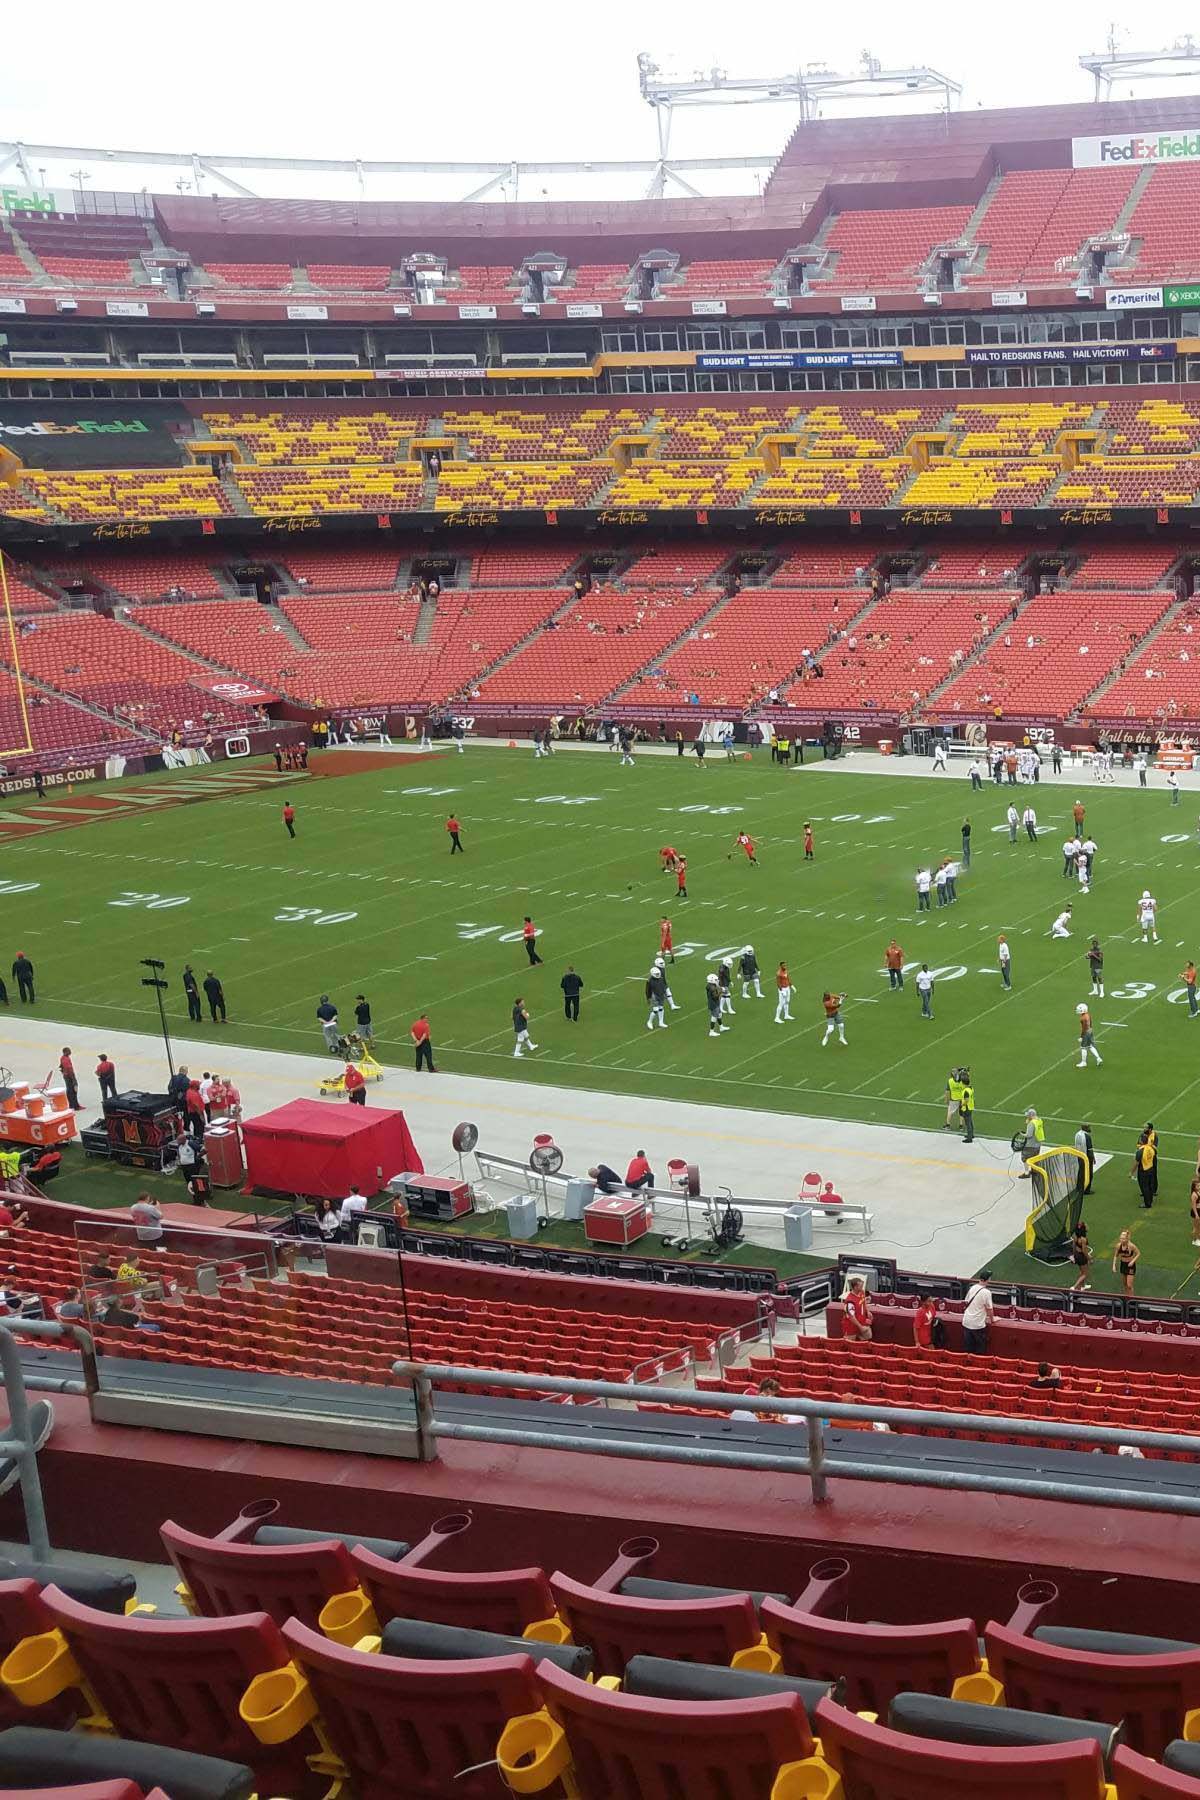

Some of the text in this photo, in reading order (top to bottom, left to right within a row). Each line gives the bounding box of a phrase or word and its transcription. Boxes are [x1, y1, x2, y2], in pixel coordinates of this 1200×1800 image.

[1101, 135, 1200, 161] FedExField
[1117, 292, 1160, 305] Ameritel
[806, 355, 849, 364] BUD LIGHT
[970, 349, 1129, 361] HAIL TO REDSKINS FANS. HAIL VICTORY!
[1140, 347, 1163, 357] FedEx
[703, 357, 745, 367] BUD LIGHT
[0, 420, 150, 436] edExField
[1125, 732, 1134, 743] to
[1135, 730, 1152, 744] the
[229, 739, 247, 755] 40
[0, 768, 97, 793] REDSINS.COM
[107, 892, 191, 910] 20
[273, 908, 359, 926] 30
[57, 1122, 69, 1137] G
